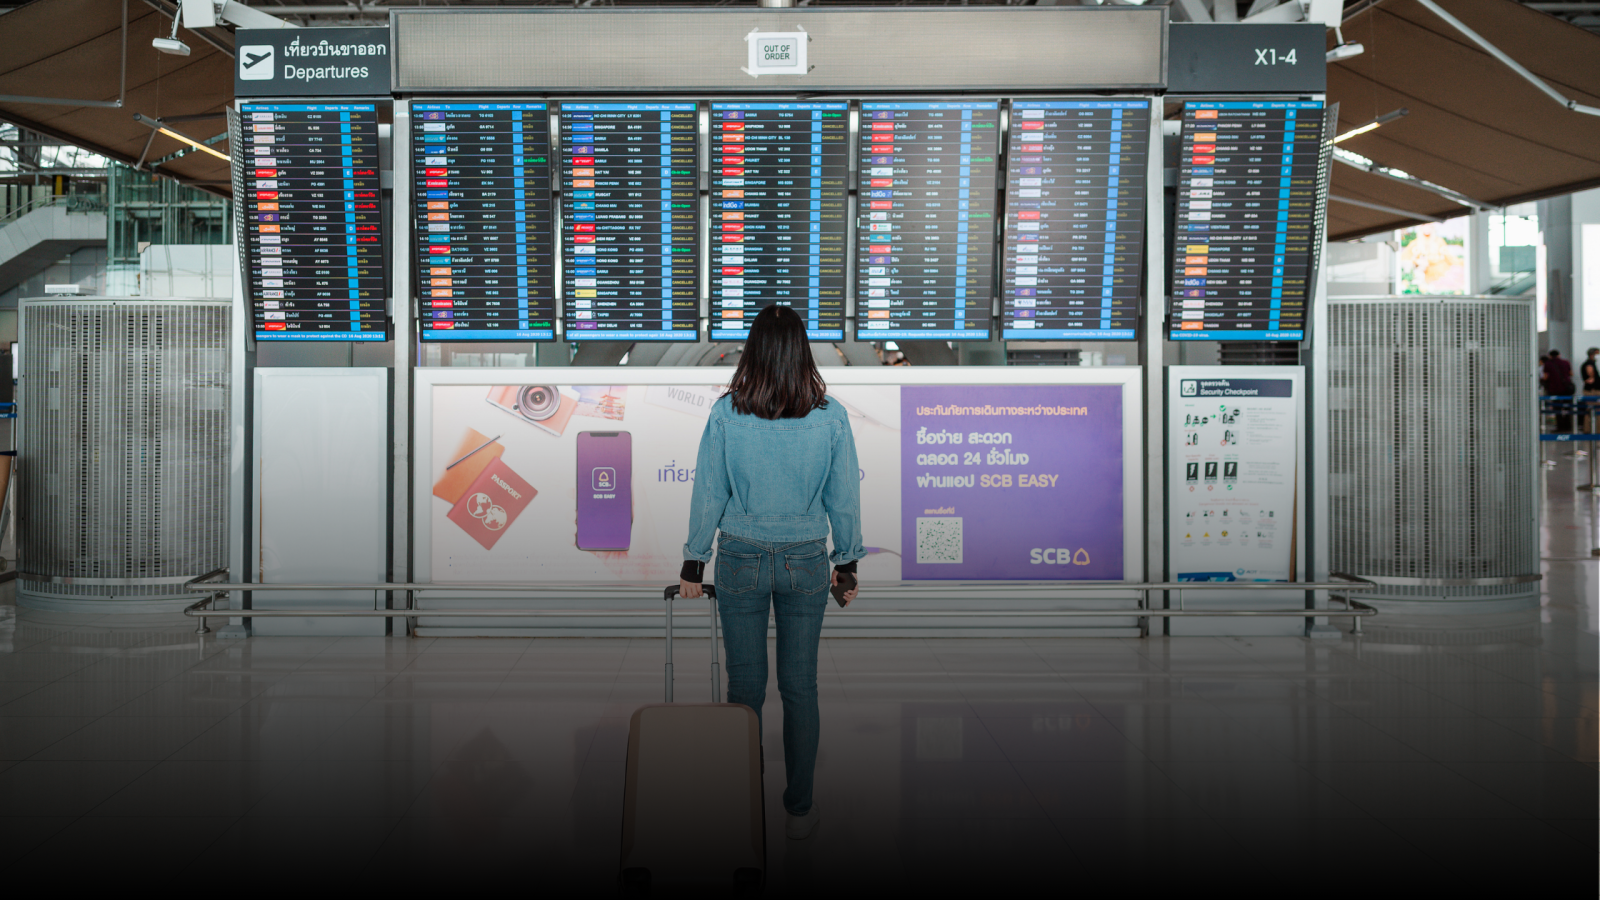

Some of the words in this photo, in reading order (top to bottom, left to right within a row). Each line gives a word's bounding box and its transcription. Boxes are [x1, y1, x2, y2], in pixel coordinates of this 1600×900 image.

[284, 36, 386, 57] เที่ยวบินขาออก
[1254, 48, 1297, 65] X1-4
[284, 65, 369, 82] Departures
[667, 387, 705, 407] WORLD
[916, 404, 1088, 416] ประกันภัยการเดินทางระหว่างประเทศ
[916, 426, 962, 445] ซื้อง่าย
[968, 431, 1012, 444] สะดวก
[916, 452, 958, 465] ตลอด
[964, 452, 981, 465] 24
[987, 447, 1029, 465] ชั่วโมง
[490, 474, 522, 500] PASSPORT
[916, 472, 974, 488] ผ่านแอป
[980, 474, 1013, 488] SCB
[1018, 474, 1059, 488] EASY
[1030, 548, 1071, 565] SCB
